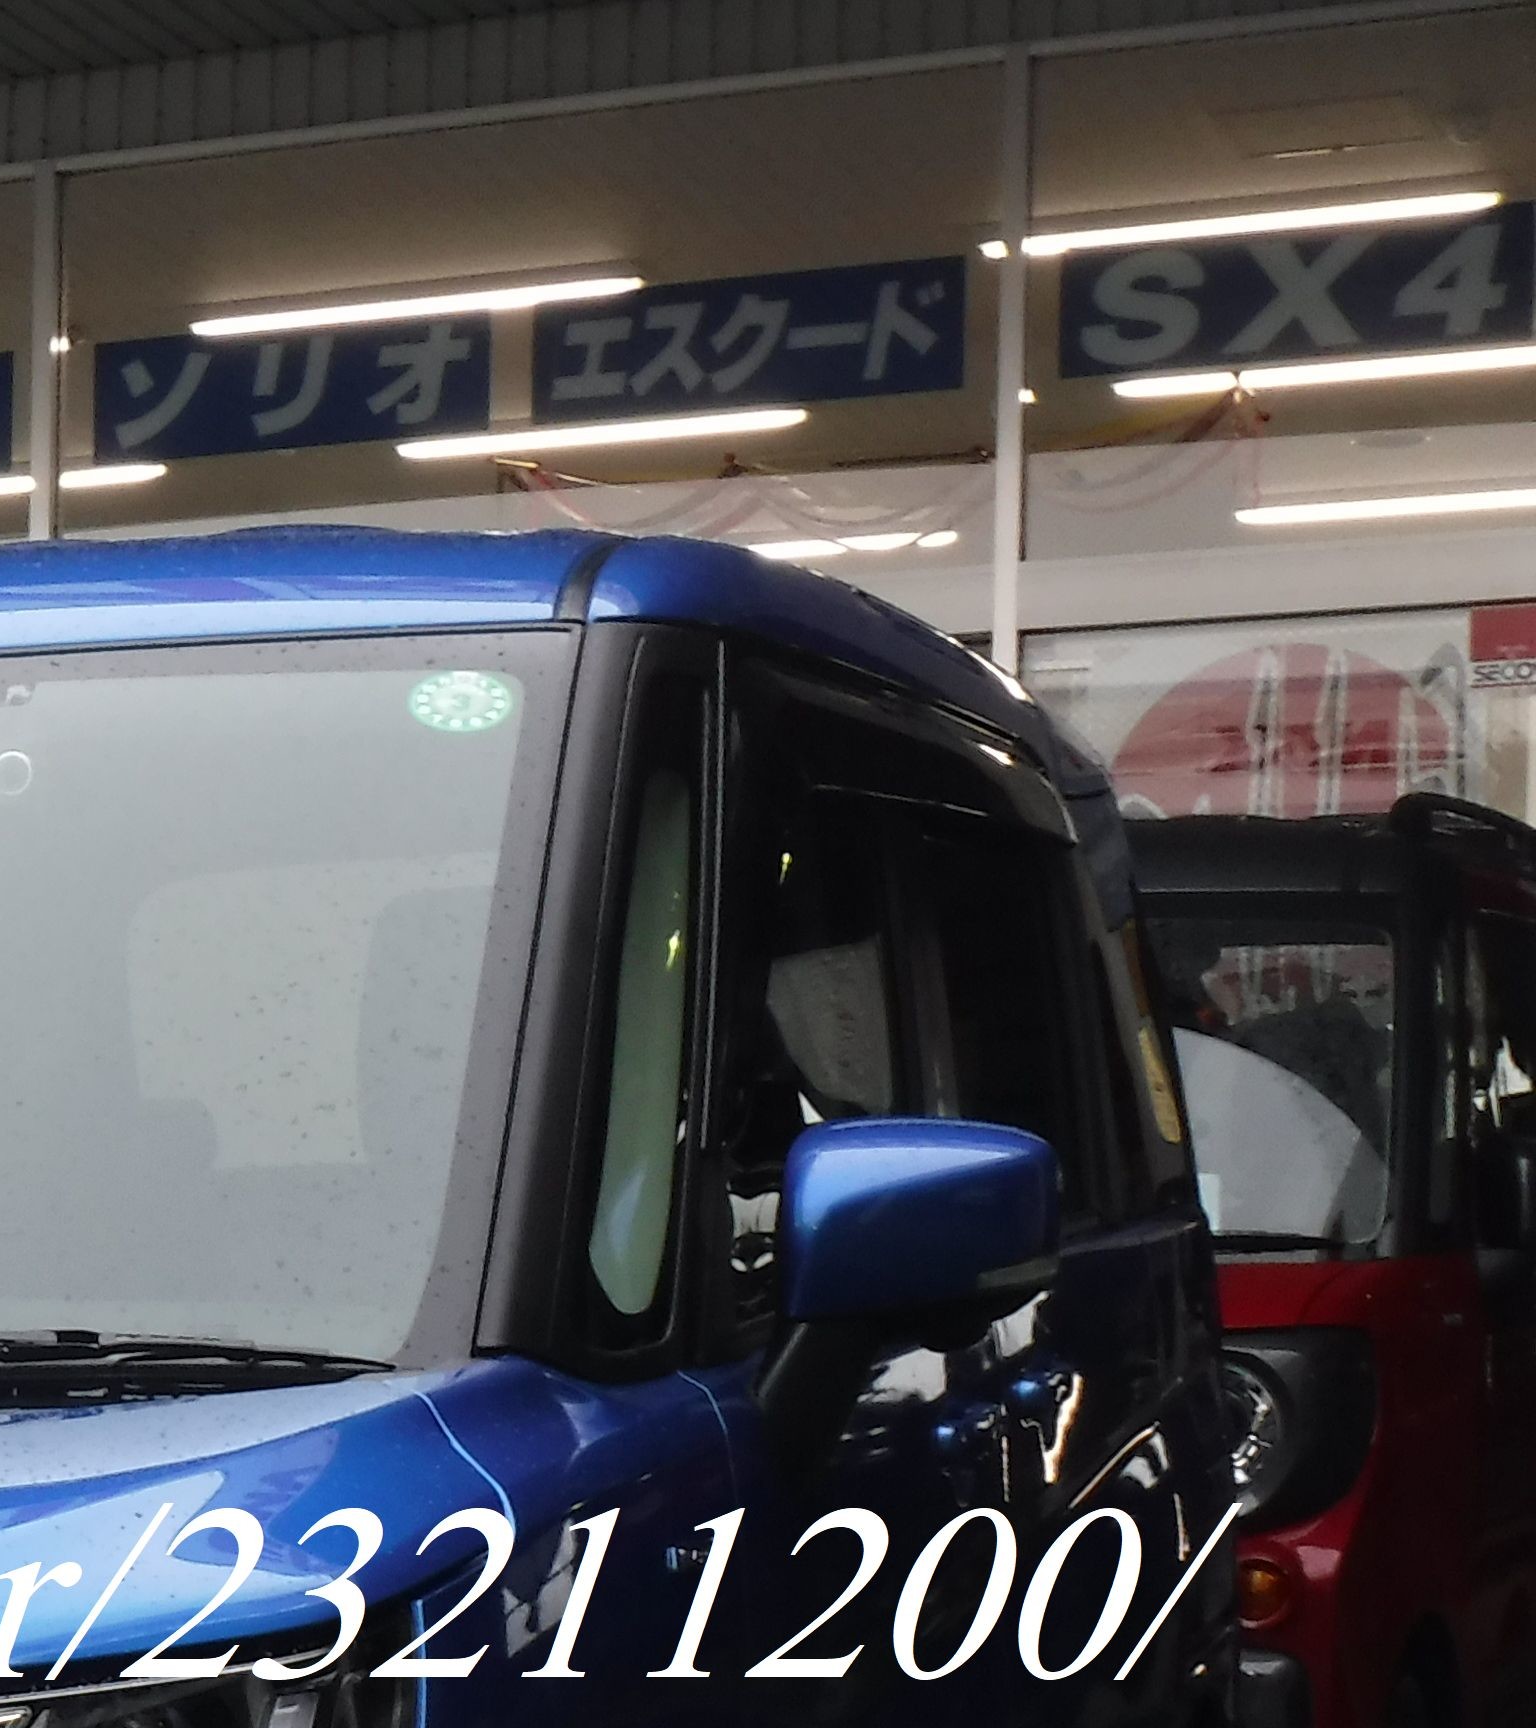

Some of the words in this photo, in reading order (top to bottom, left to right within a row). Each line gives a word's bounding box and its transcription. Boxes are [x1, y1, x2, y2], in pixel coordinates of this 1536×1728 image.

[550, 279, 946, 401] エスクード
[1079, 222, 1509, 365] SX4
[115, 321, 471, 449] ソリオ
